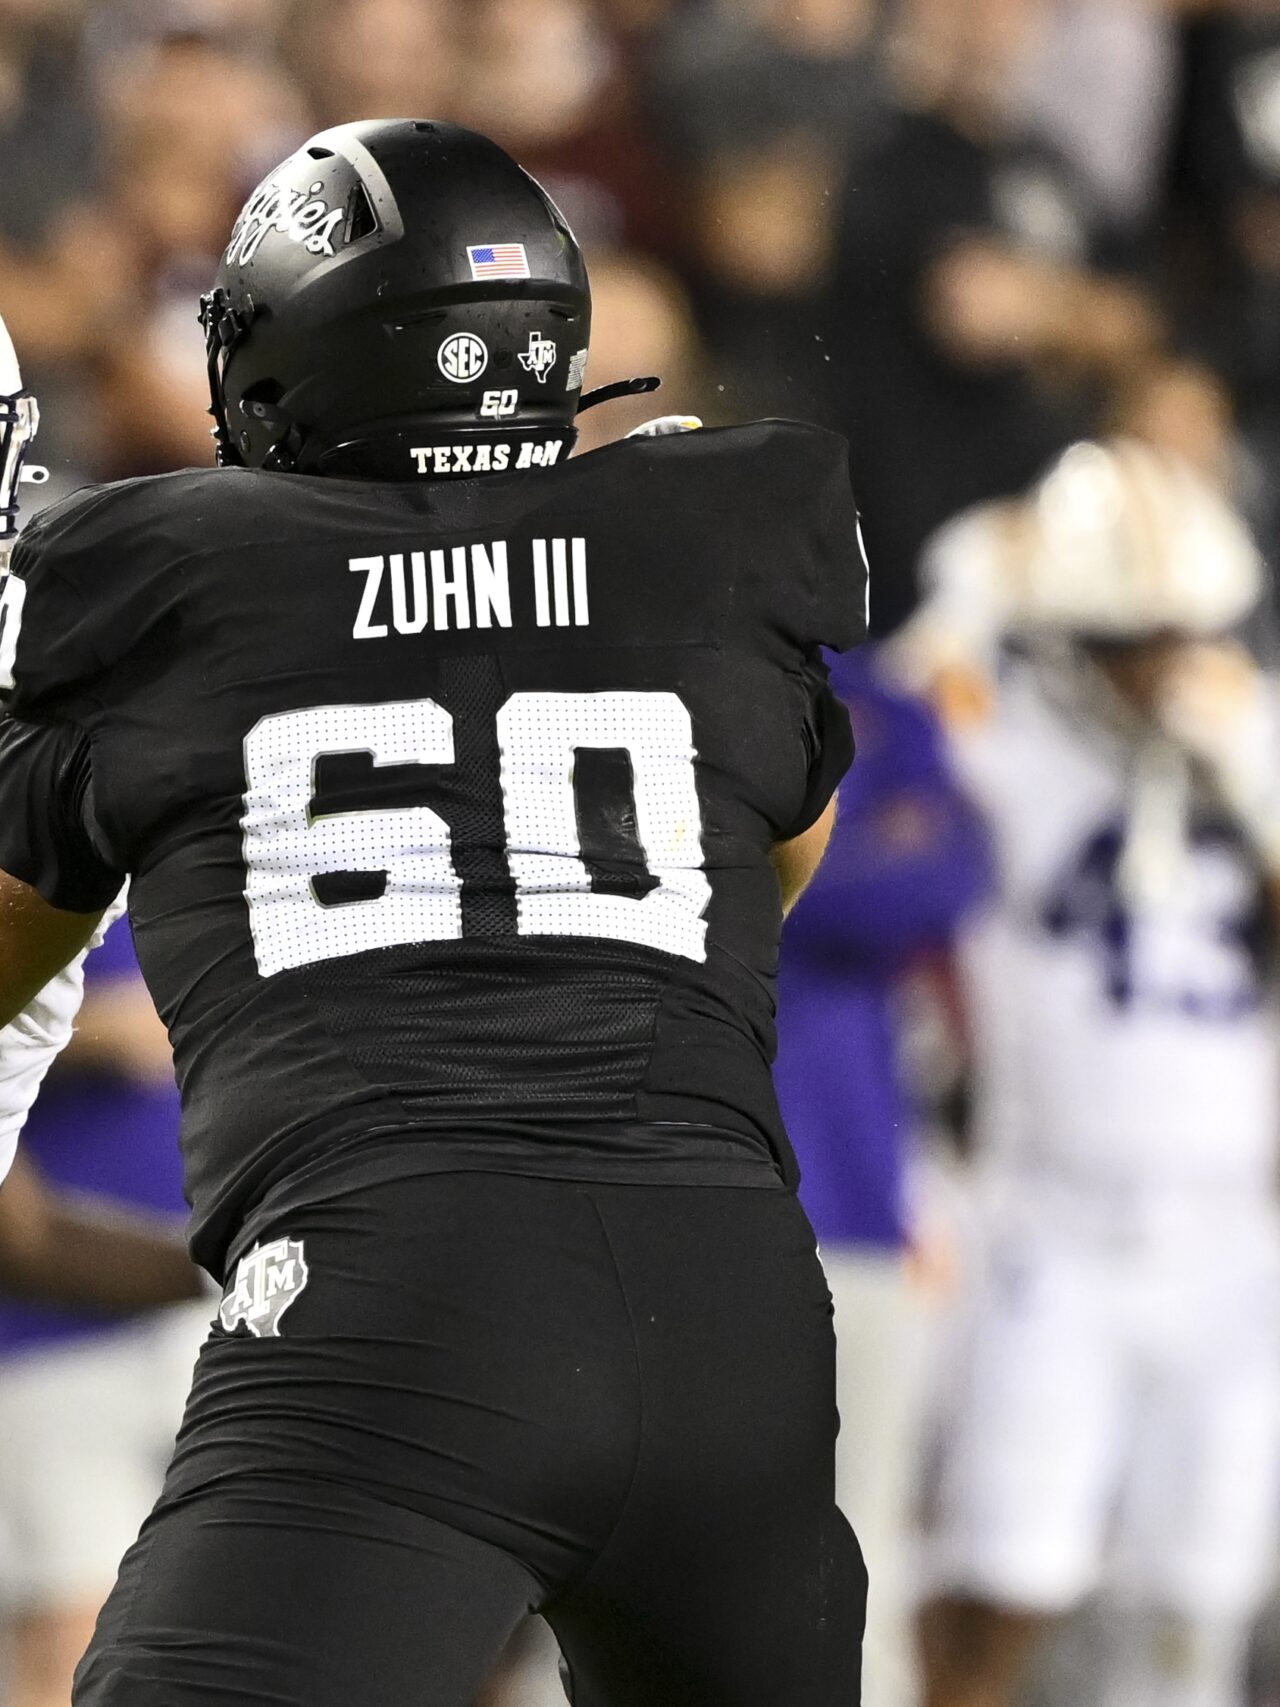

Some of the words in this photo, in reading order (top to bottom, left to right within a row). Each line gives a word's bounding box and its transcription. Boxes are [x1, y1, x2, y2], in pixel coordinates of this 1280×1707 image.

[442, 336, 484, 379] SEC
[480, 389, 518, 417] 60
[409, 444, 511, 474] TEXAS
[348, 540, 513, 640] ZUHN
[531, 537, 590, 628] III
[239, 691, 713, 978] 60
